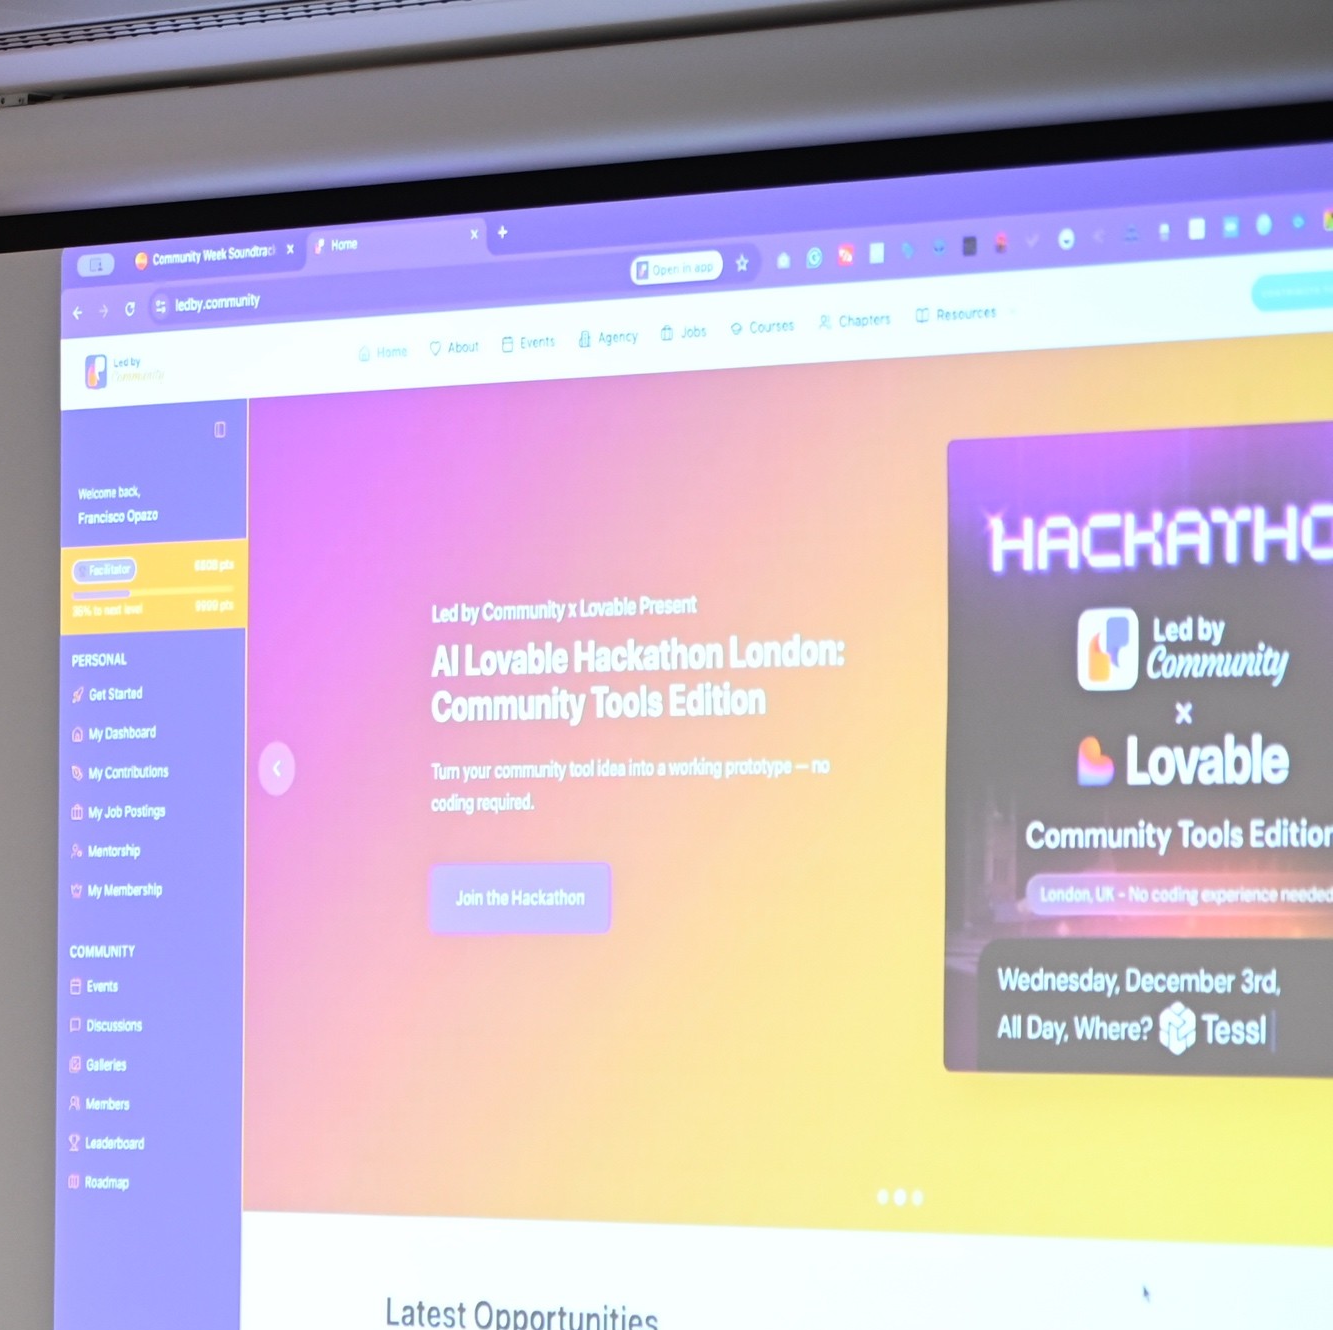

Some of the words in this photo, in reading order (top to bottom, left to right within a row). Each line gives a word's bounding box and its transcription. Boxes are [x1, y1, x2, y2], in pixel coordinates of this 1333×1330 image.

[331, 237, 358, 253] Home
[153, 249, 201, 266] Community
[203, 247, 227, 261] Week
[652, 263, 680, 278] Open
[683, 262, 691, 274] in
[694, 261, 714, 275] app
[175, 293, 261, 313] ledby.community
[838, 312, 891, 330] Chapters
[936, 306, 997, 321] Resources
[681, 325, 707, 339] Jobs
[749, 319, 795, 335] Courses
[520, 336, 556, 349] Events
[599, 331, 638, 346] Agency
[377, 346, 408, 359] Home
[448, 341, 479, 354] About
[113, 358, 128, 368] Led
[130, 357, 141, 368] by
[78, 486, 117, 500] Welcome
[118, 485, 141, 498] back,
[78, 510, 125, 524] Francisco
[127, 509, 158, 524] Opazo
[89, 564, 131, 576] Facilitator
[432, 604, 459, 623] Led
[461, 603, 479, 625] by
[482, 600, 565, 622] Community
[568, 604, 577, 618] x
[580, 597, 636, 618] Lovable
[639, 595, 697, 616] Present
[1153, 615, 1193, 643] Led
[1198, 615, 1226, 646] by
[72, 653, 127, 667] PERSONAL
[431, 644, 459, 677] AI
[465, 641, 568, 675] Lovable
[574, 637, 723, 673] Hackathon
[729, 633, 845, 669] London:
[1146, 641, 1290, 688] Community
[89, 688, 106, 701] Get
[108, 686, 143, 700] Started
[431, 687, 586, 726] Community
[591, 685, 663, 718] Tools
[669, 682, 766, 716] Edition
[89, 728, 103, 743] My
[105, 725, 156, 740] Dashboard
[1126, 732, 1290, 786] Lovable
[89, 766, 103, 782] My
[105, 765, 169, 779] Contributions
[431, 762, 460, 780] Turn
[462, 764, 492, 783] your
[494, 760, 566, 783] community
[569, 759, 594, 778] tool
[597, 758, 626, 777] idea
[628, 758, 654, 777] into
[657, 762, 666, 776] a
[668, 757, 722, 779] working
[725, 757, 792, 779] prototype
[812, 760, 830, 774] no
[431, 794, 474, 815] coding
[477, 793, 535, 814] required.
[88, 806, 102, 821] My
[104, 805, 122, 819] Job
[125, 805, 165, 820] Postings
[1026, 819, 1172, 856] Community
[1178, 818, 1244, 849] Tools
[88, 844, 140, 859] Mentorship
[88, 884, 102, 899] My
[104, 882, 162, 898] Membership
[456, 889, 483, 907] Join
[486, 889, 509, 906] the
[511, 888, 585, 906] Hackathon
[1040, 886, 1093, 904] London,
[1096, 887, 1115, 902] UK
[1129, 886, 1149, 902] No
[1151, 886, 1198, 906] coding
[1201, 886, 1278, 905] experience
[70, 945, 135, 958] COMMUNITY
[87, 979, 118, 993] Events
[997, 966, 1120, 998] Wednesday,
[1126, 967, 1236, 994] December
[1240, 967, 1281, 996] 3rd,
[86, 1019, 142, 1032] Discussions
[997, 1014, 1021, 1040] All
[1027, 1015, 1069, 1045] Day,
[1074, 1014, 1154, 1041] Where?
[1202, 1013, 1266, 1045] Tessl
[86, 1058, 126, 1072] Galleries
[86, 1097, 130, 1111] Members
[85, 1137, 145, 1151] Leaderboard
[85, 1176, 129, 1191] Roadmap
[387, 1297, 466, 1329] Latest
